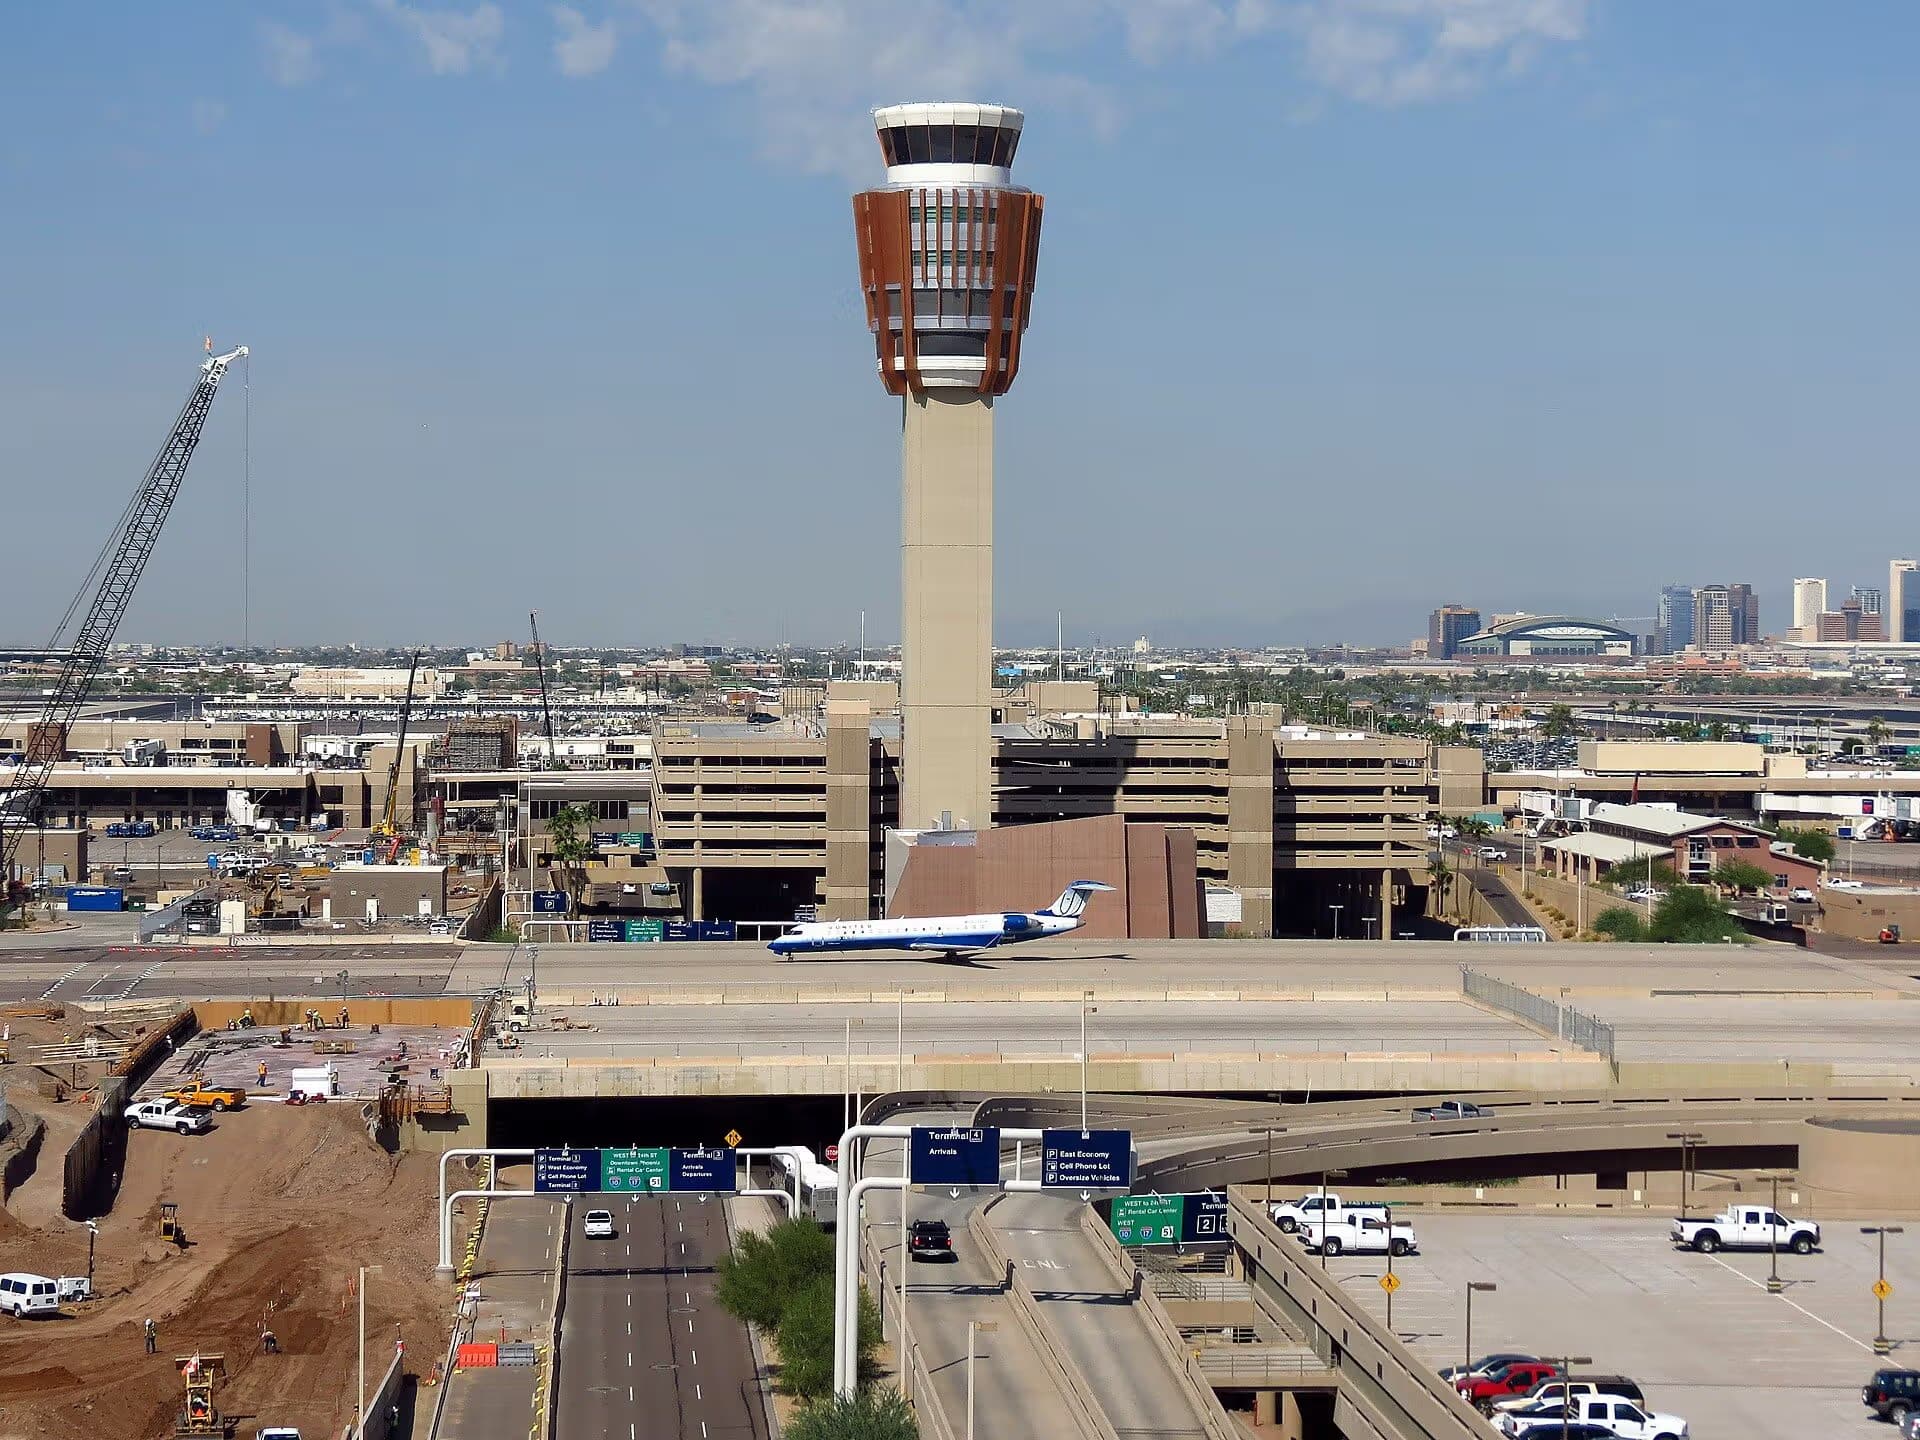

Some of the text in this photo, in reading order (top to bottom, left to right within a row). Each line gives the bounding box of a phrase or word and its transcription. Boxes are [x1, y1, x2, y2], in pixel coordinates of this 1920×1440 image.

[928, 1131, 969, 1140] Terminal
[682, 1151, 713, 1159] Terminal
[1077, 1151, 1110, 1159] Economy
[1091, 1174, 1120, 1182] Vehicles
[1202, 1218, 1210, 1230] 2
